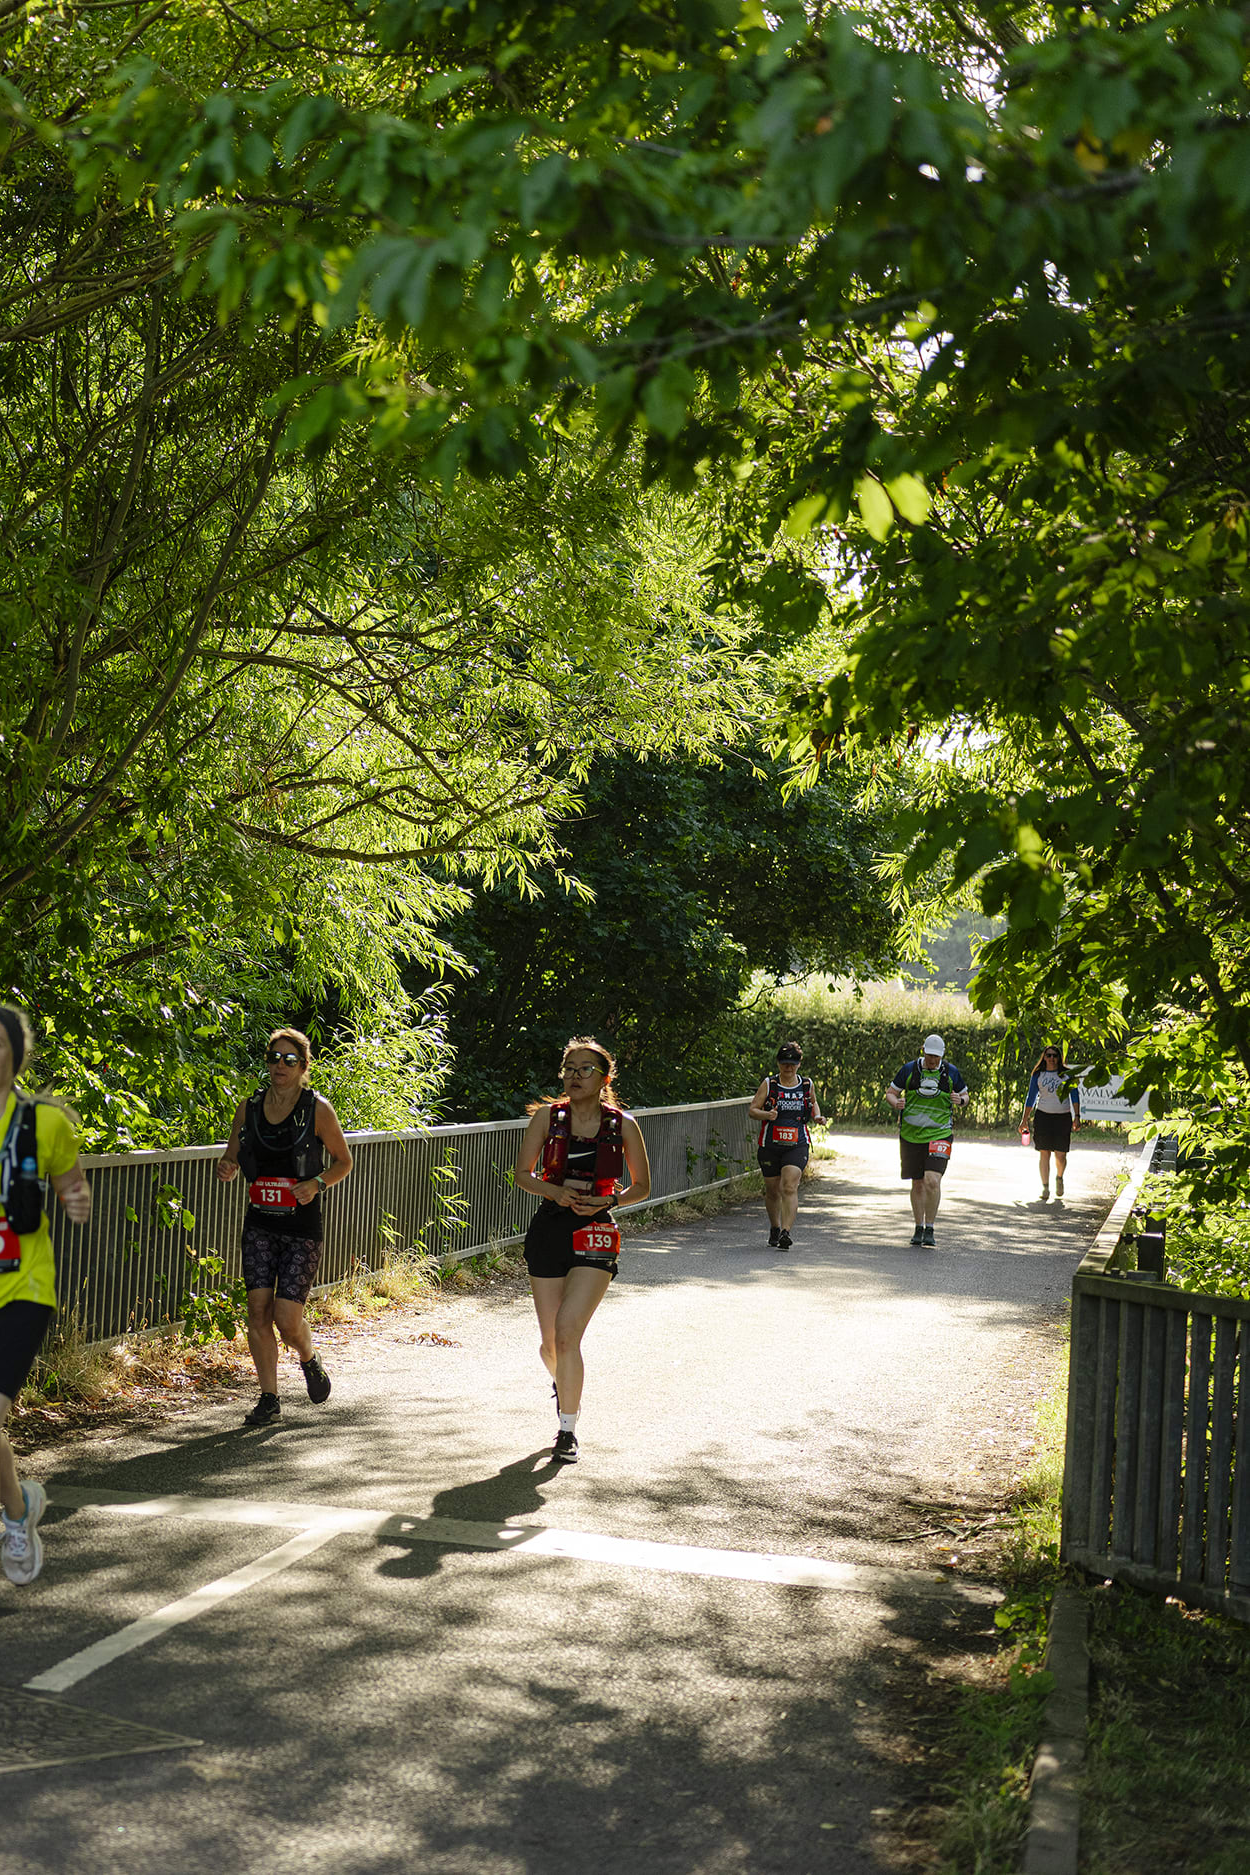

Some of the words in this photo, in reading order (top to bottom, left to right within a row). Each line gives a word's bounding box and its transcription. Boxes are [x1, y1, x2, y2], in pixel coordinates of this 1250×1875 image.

[779, 1132, 793, 1140] 183
[260, 1188, 282, 1203] 131
[587, 1233, 613, 1248] 139
